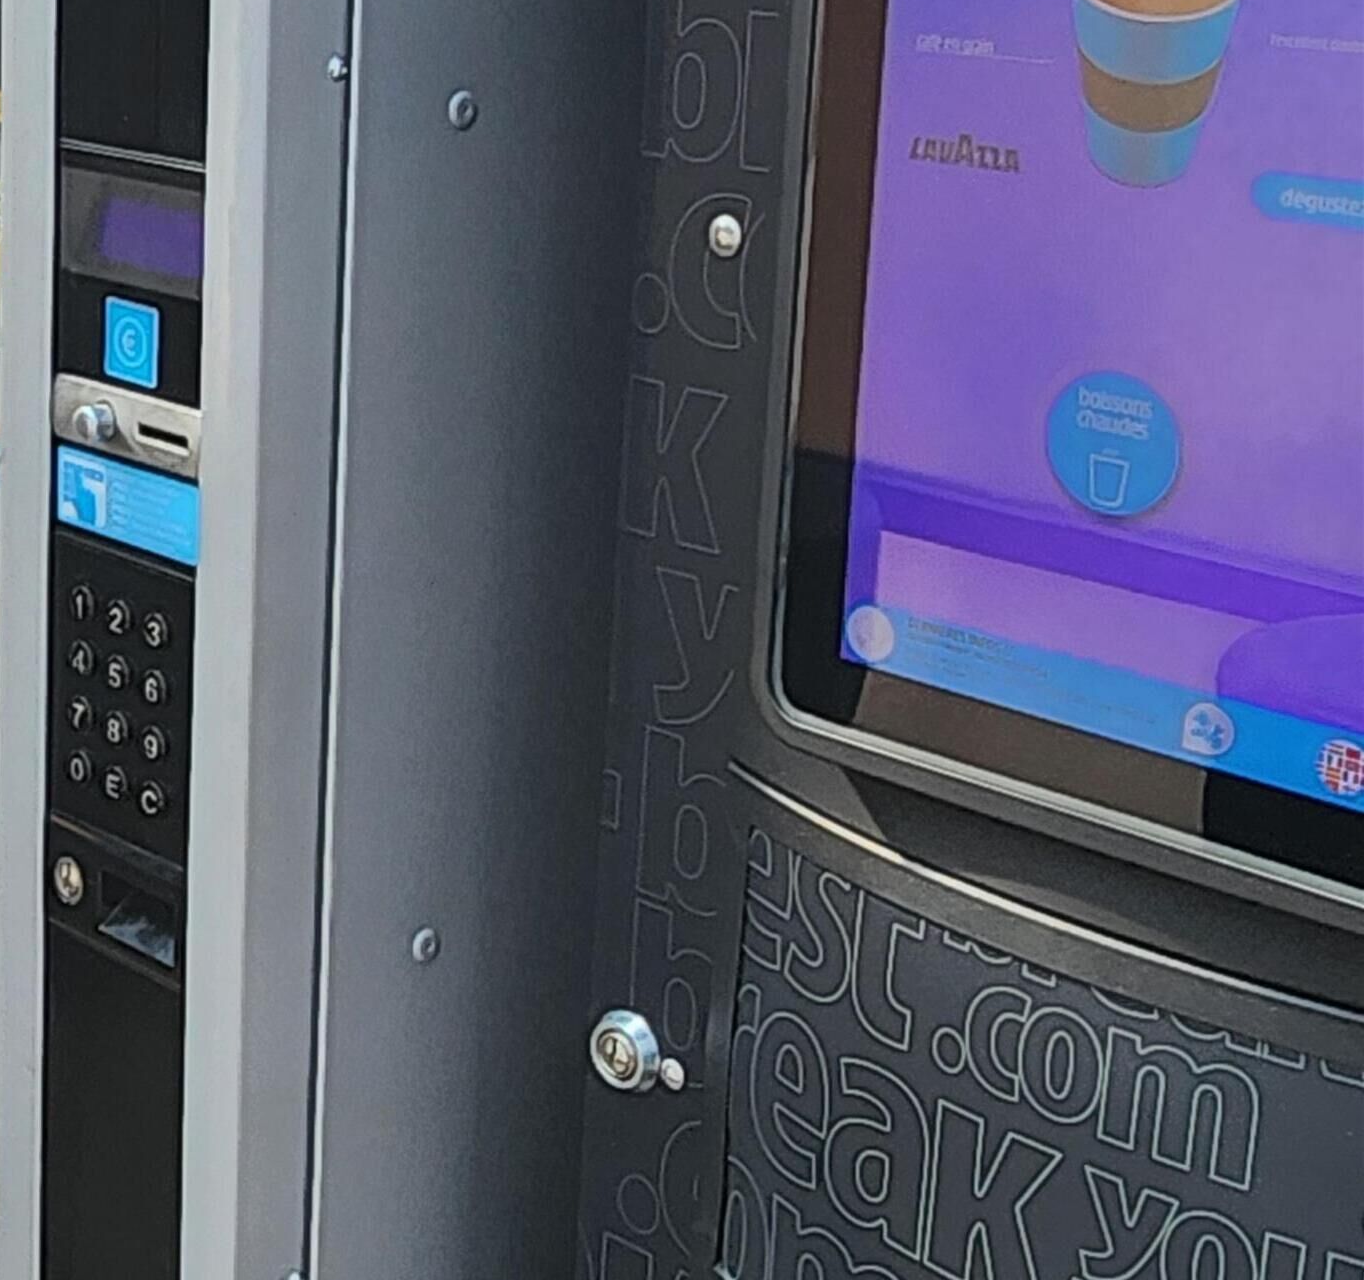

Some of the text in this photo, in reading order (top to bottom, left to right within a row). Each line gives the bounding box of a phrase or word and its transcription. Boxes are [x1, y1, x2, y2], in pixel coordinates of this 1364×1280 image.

[1076, 409, 1150, 440] chaudes
[1077, 385, 1154, 420] boissons
[75, 594, 162, 648] 1 2 3
[70, 648, 159, 703] 4 5 6
[72, 703, 158, 760] 7 8 9
[69, 757, 158, 815] 0 E C
[742, 826, 928, 1050] est
[931, 983, 1262, 1192] .com
